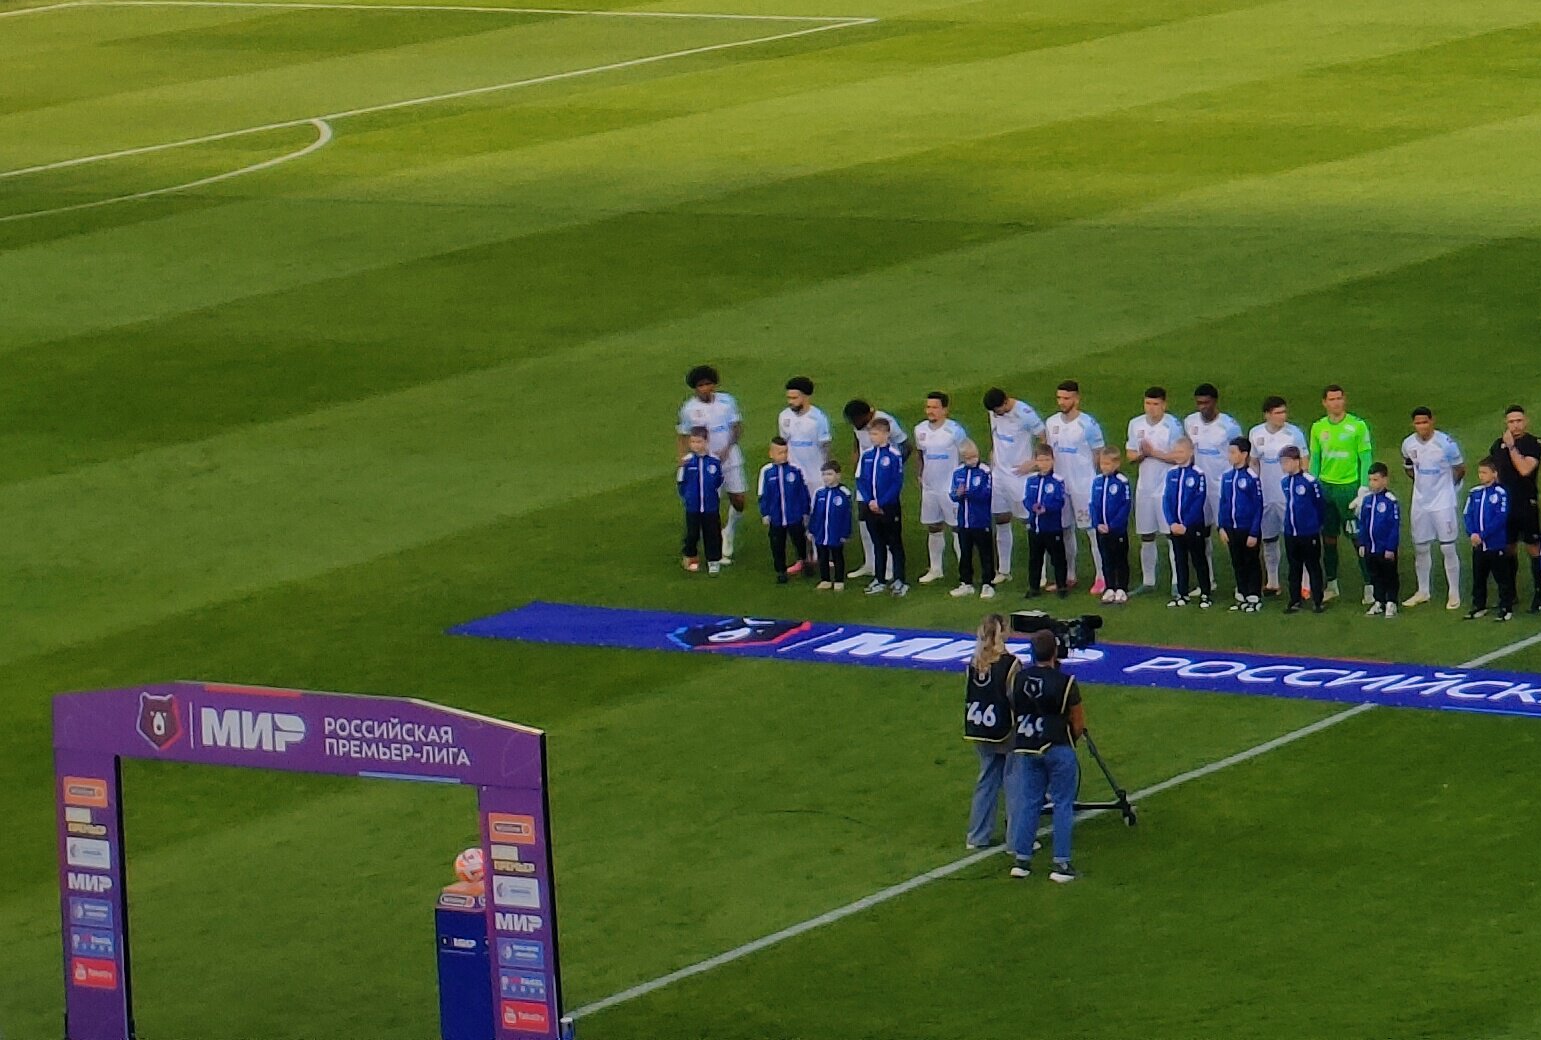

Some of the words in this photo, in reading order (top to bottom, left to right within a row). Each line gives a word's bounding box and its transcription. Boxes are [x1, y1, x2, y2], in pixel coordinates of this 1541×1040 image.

[202, 708, 305, 751] МИР
[324, 717, 453, 743] РОССИЙСКАЯ
[325, 740, 471, 766] ПРЕМЬЕР-ЛИГА
[68, 873, 112, 892] МИР
[494, 913, 543, 932] МИР
